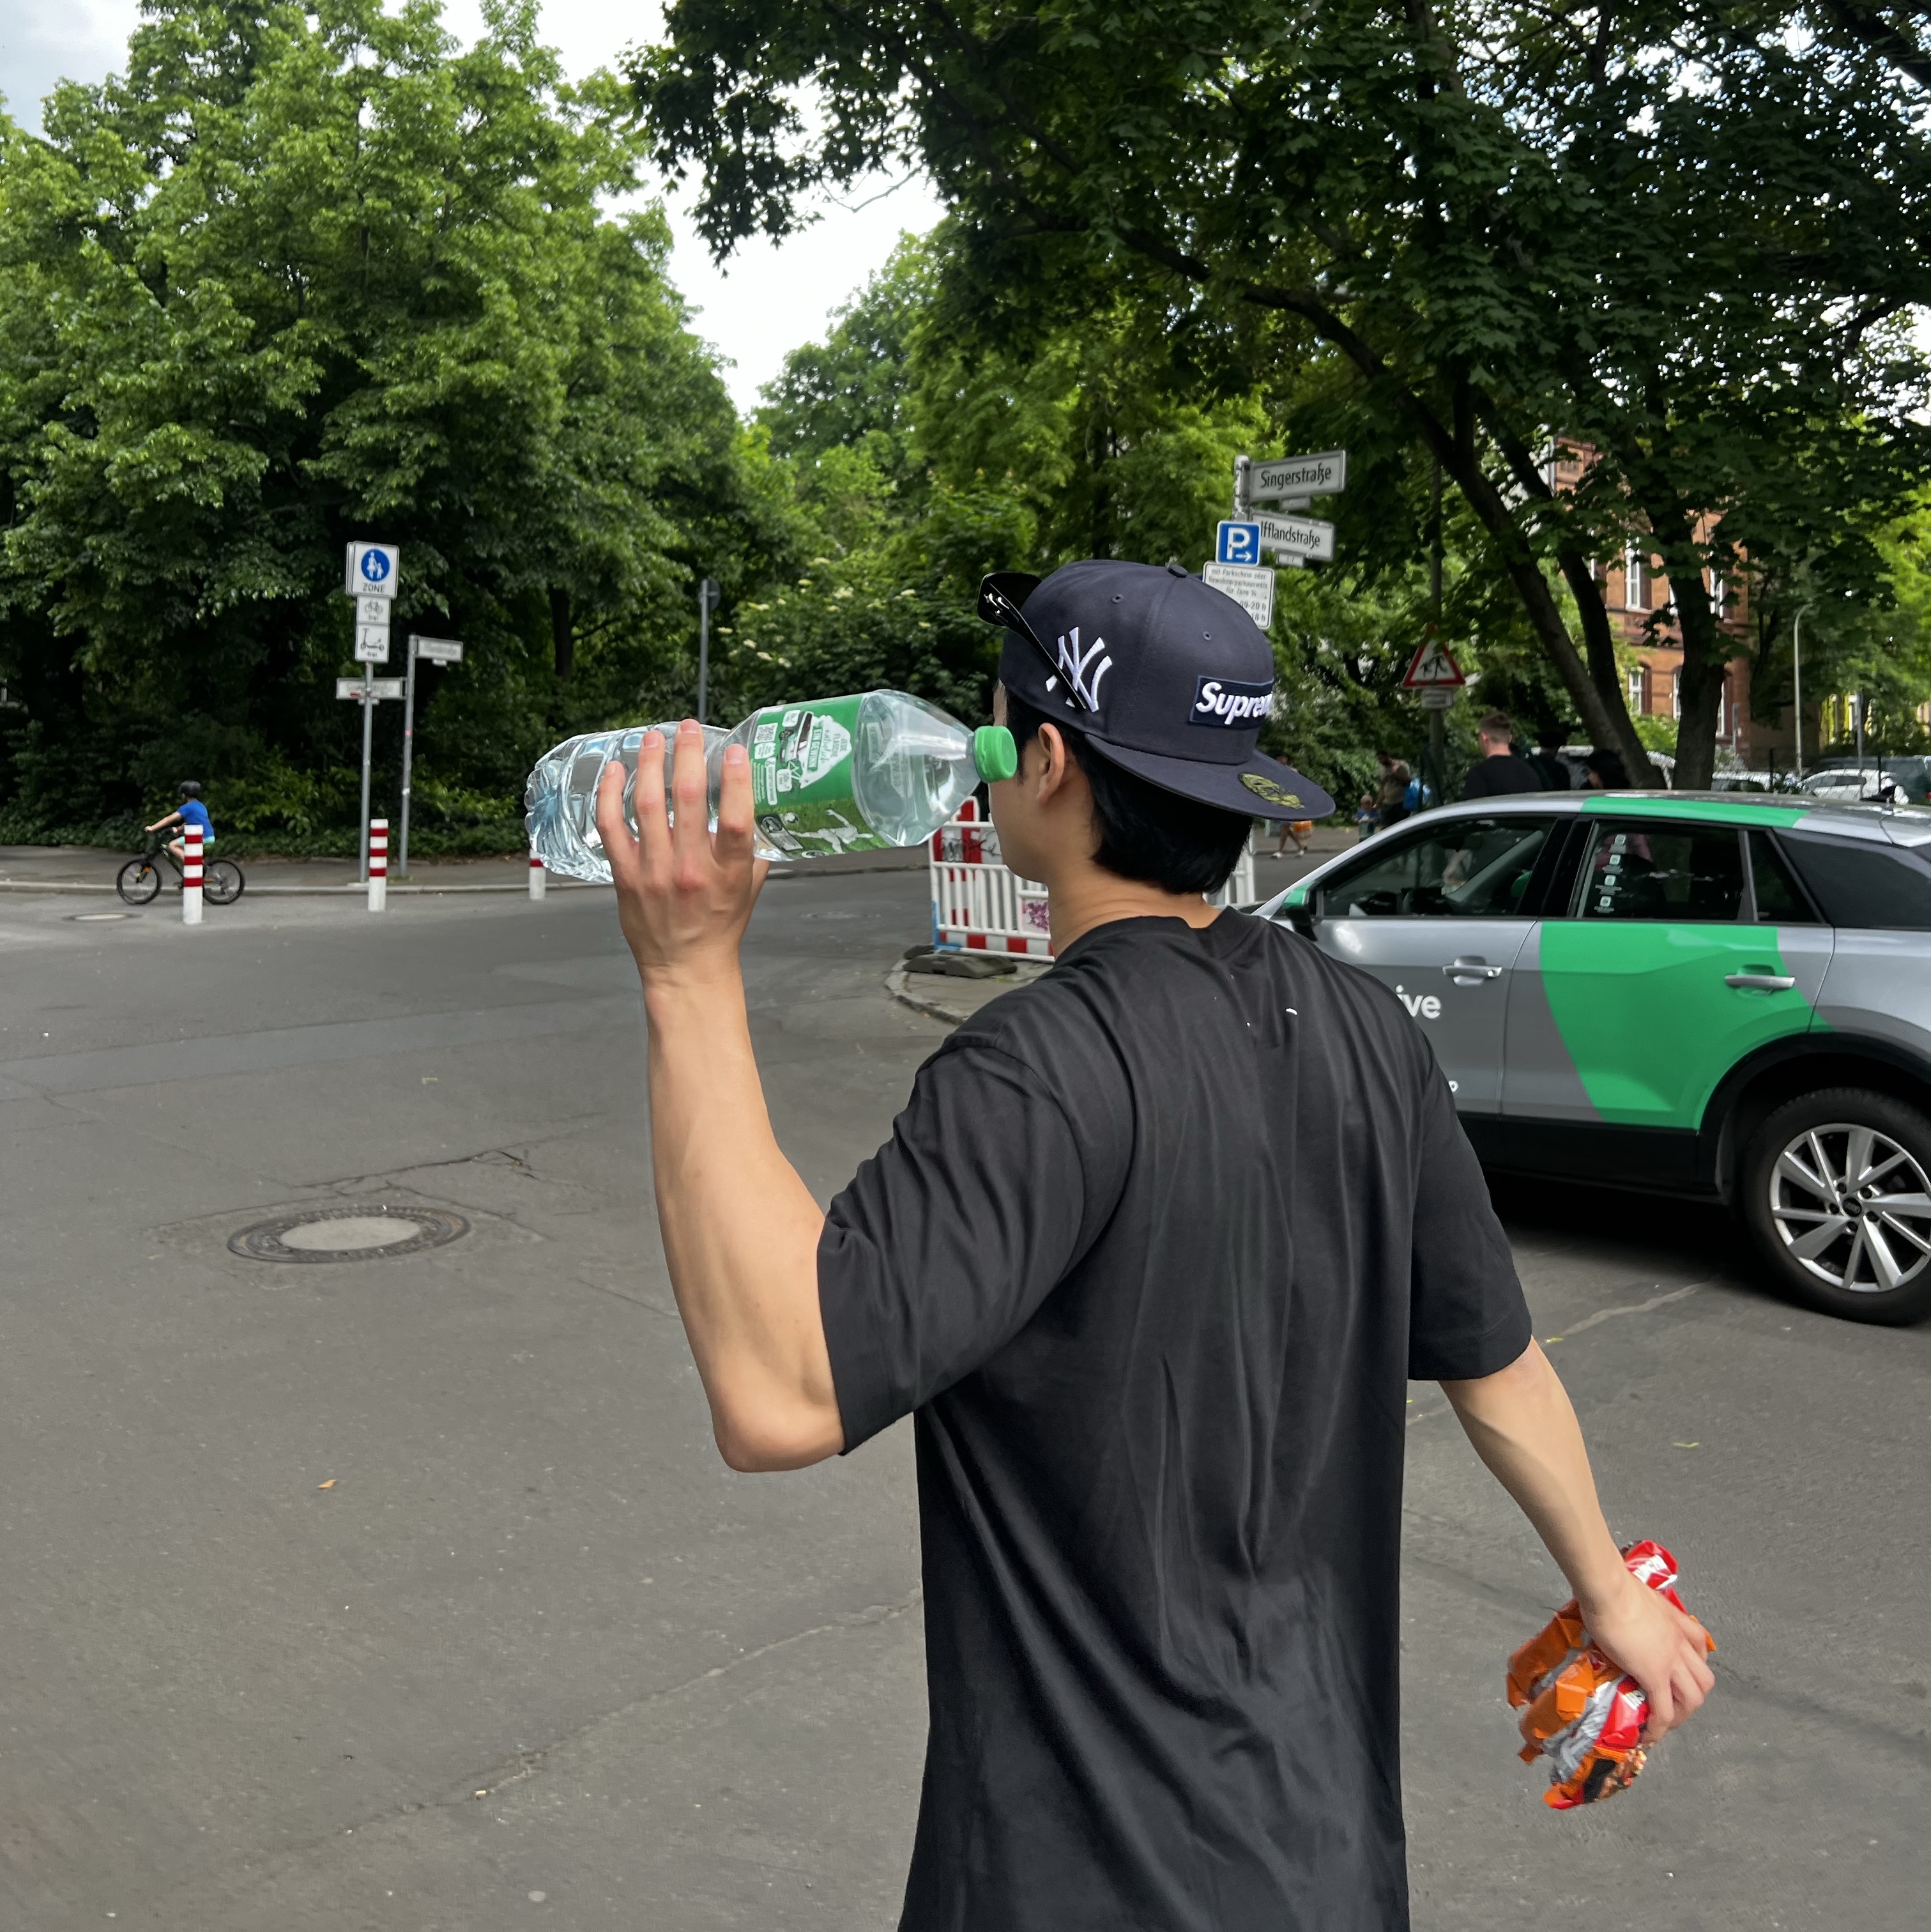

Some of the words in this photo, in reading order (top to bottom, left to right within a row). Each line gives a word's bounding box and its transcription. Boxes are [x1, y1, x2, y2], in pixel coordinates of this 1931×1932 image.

[1260, 463, 1332, 490] Singerstraße
[1260, 521, 1320, 549] Ifflandstraße
[1226, 528, 1250, 560] P
[1223, 569, 1252, 578] Parkschein
[1262, 602, 1266, 611] h
[1261, 613, 1265, 622] h
[813, 729, 822, 740] EIN
